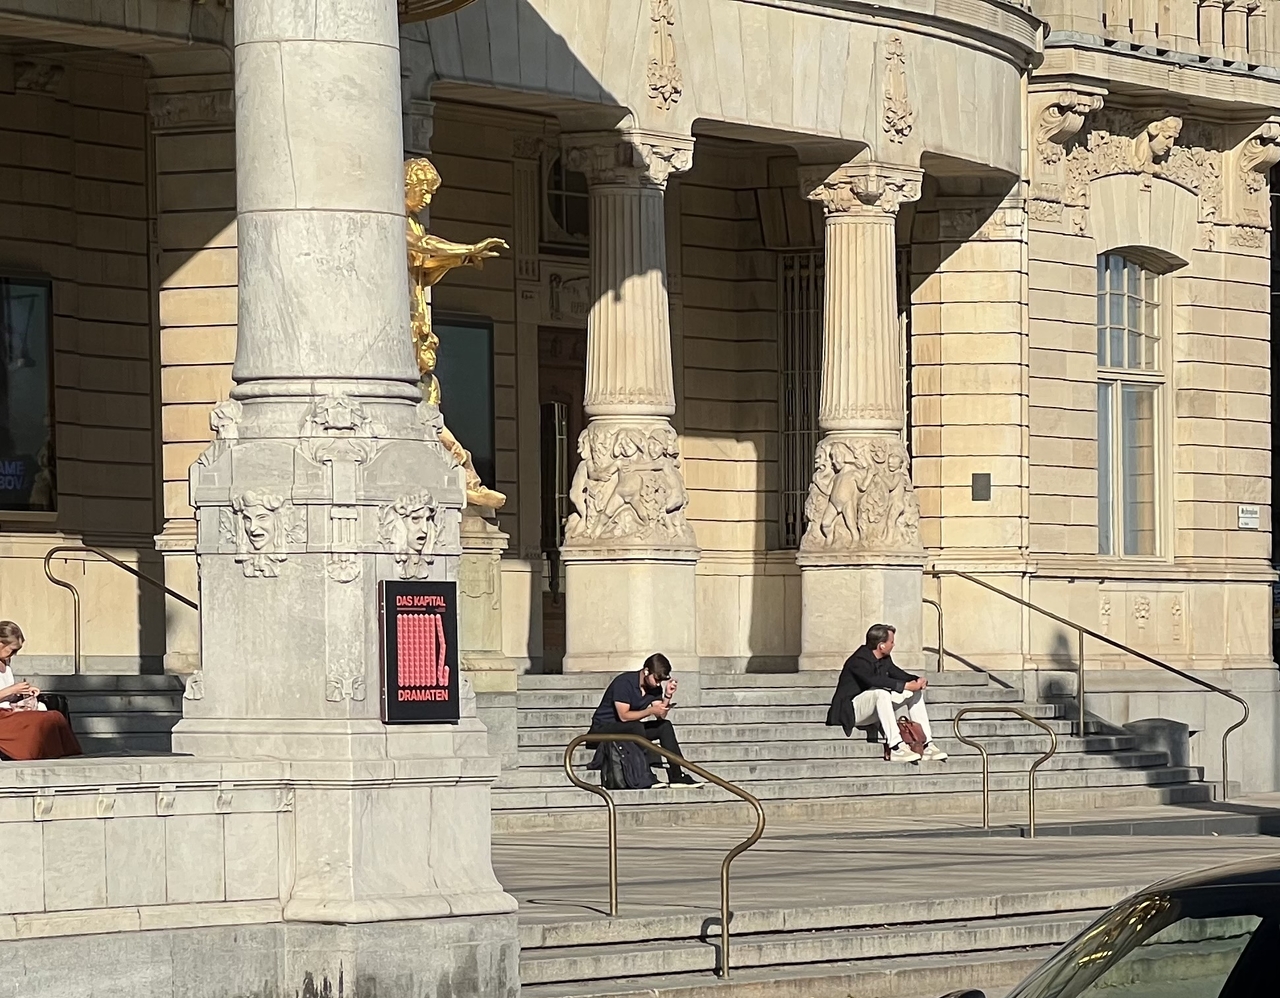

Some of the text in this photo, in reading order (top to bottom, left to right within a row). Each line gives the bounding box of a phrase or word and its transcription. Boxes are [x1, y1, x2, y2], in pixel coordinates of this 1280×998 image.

[396, 595, 446, 607] DAS KAPITAL
[397, 689, 448, 701] DRAMATEN
